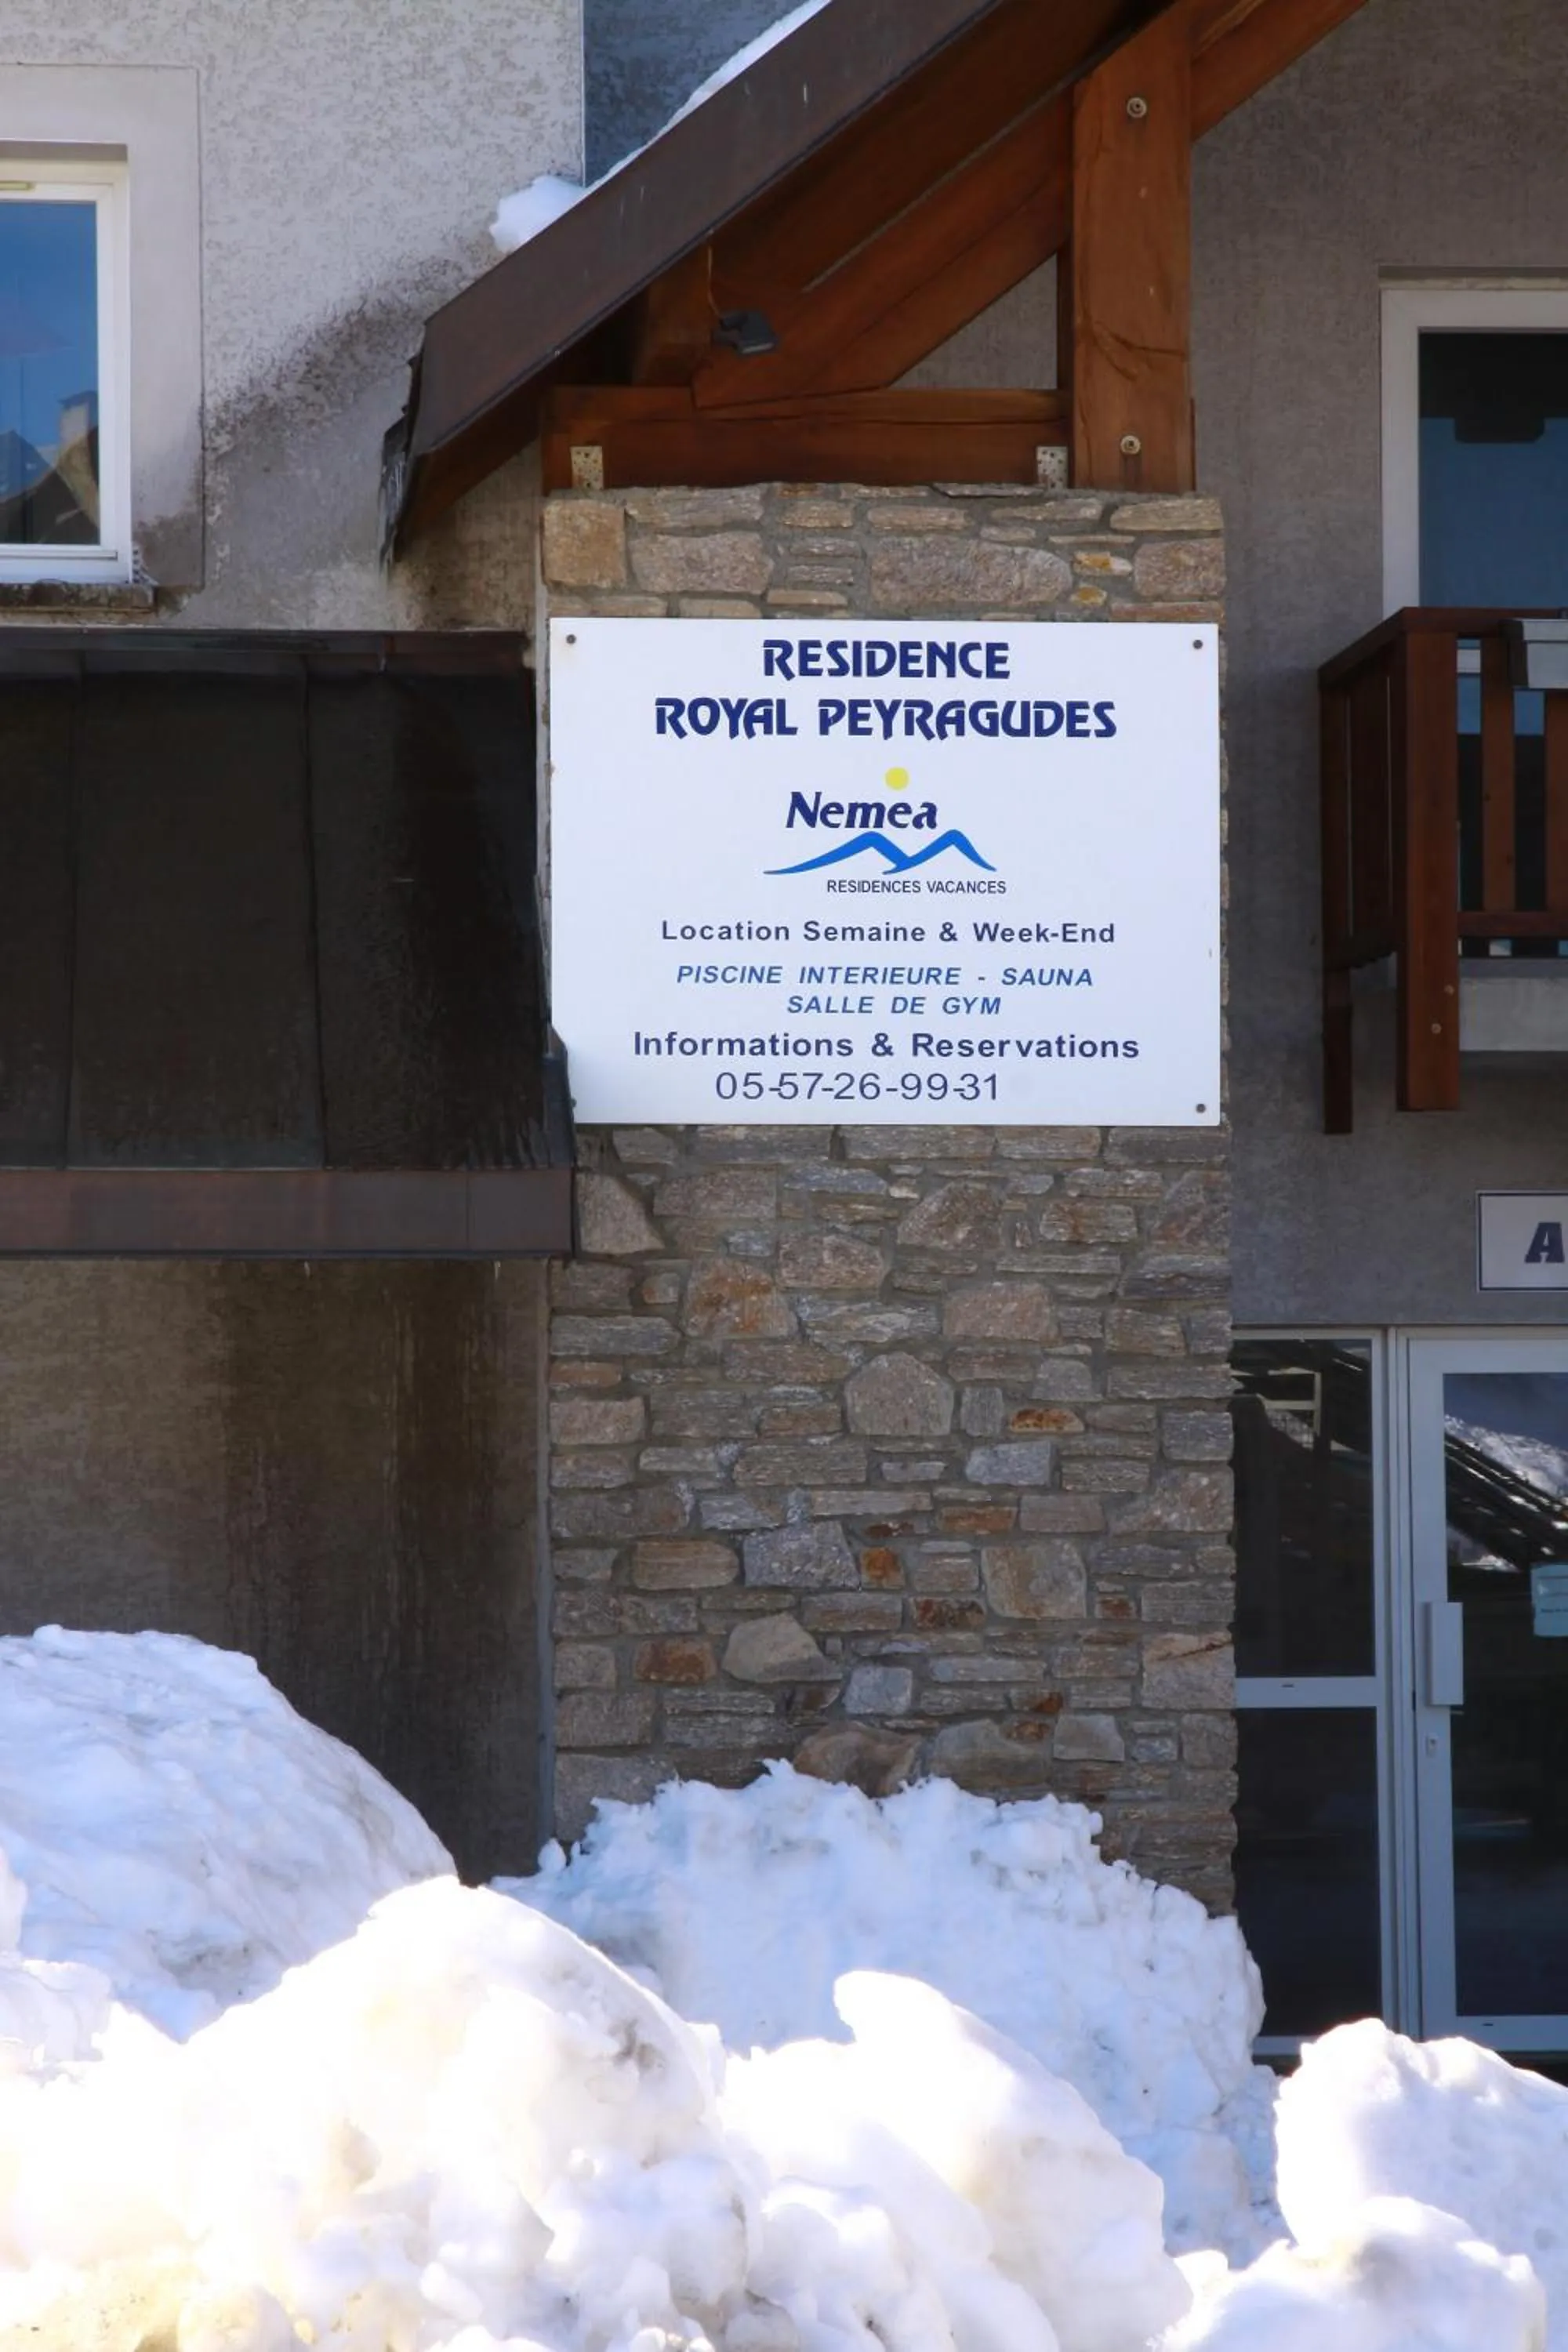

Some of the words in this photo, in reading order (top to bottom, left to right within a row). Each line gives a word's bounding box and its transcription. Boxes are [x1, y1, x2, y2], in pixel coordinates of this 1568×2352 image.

[763, 639, 1011, 681] RESIDENCE
[655, 697, 798, 740] ROYAL
[818, 699, 1117, 741] PEYRAGUDES
[786, 791, 938, 830] Nemea
[827, 879, 921, 894] RESIDENCES
[926, 880, 1007, 895] VACANCES
[662, 920, 789, 941] Location
[803, 920, 926, 942] Semaine
[938, 921, 958, 942] &
[973, 922, 1114, 943] Week-End
[677, 965, 783, 984] PISCINE
[799, 967, 961, 985] INTERIEURE
[1001, 967, 1092, 986] SAUNA
[787, 995, 874, 1014] SALLE
[891, 996, 926, 1014] DE
[942, 996, 1001, 1015] GYM
[634, 1031, 854, 1057] Informations
[871, 1033, 894, 1058] &
[912, 1033, 1139, 1058] Reservations
[716, 1072, 996, 1101] 05-57-26-99-31
[1524, 1221, 1565, 1264] A
